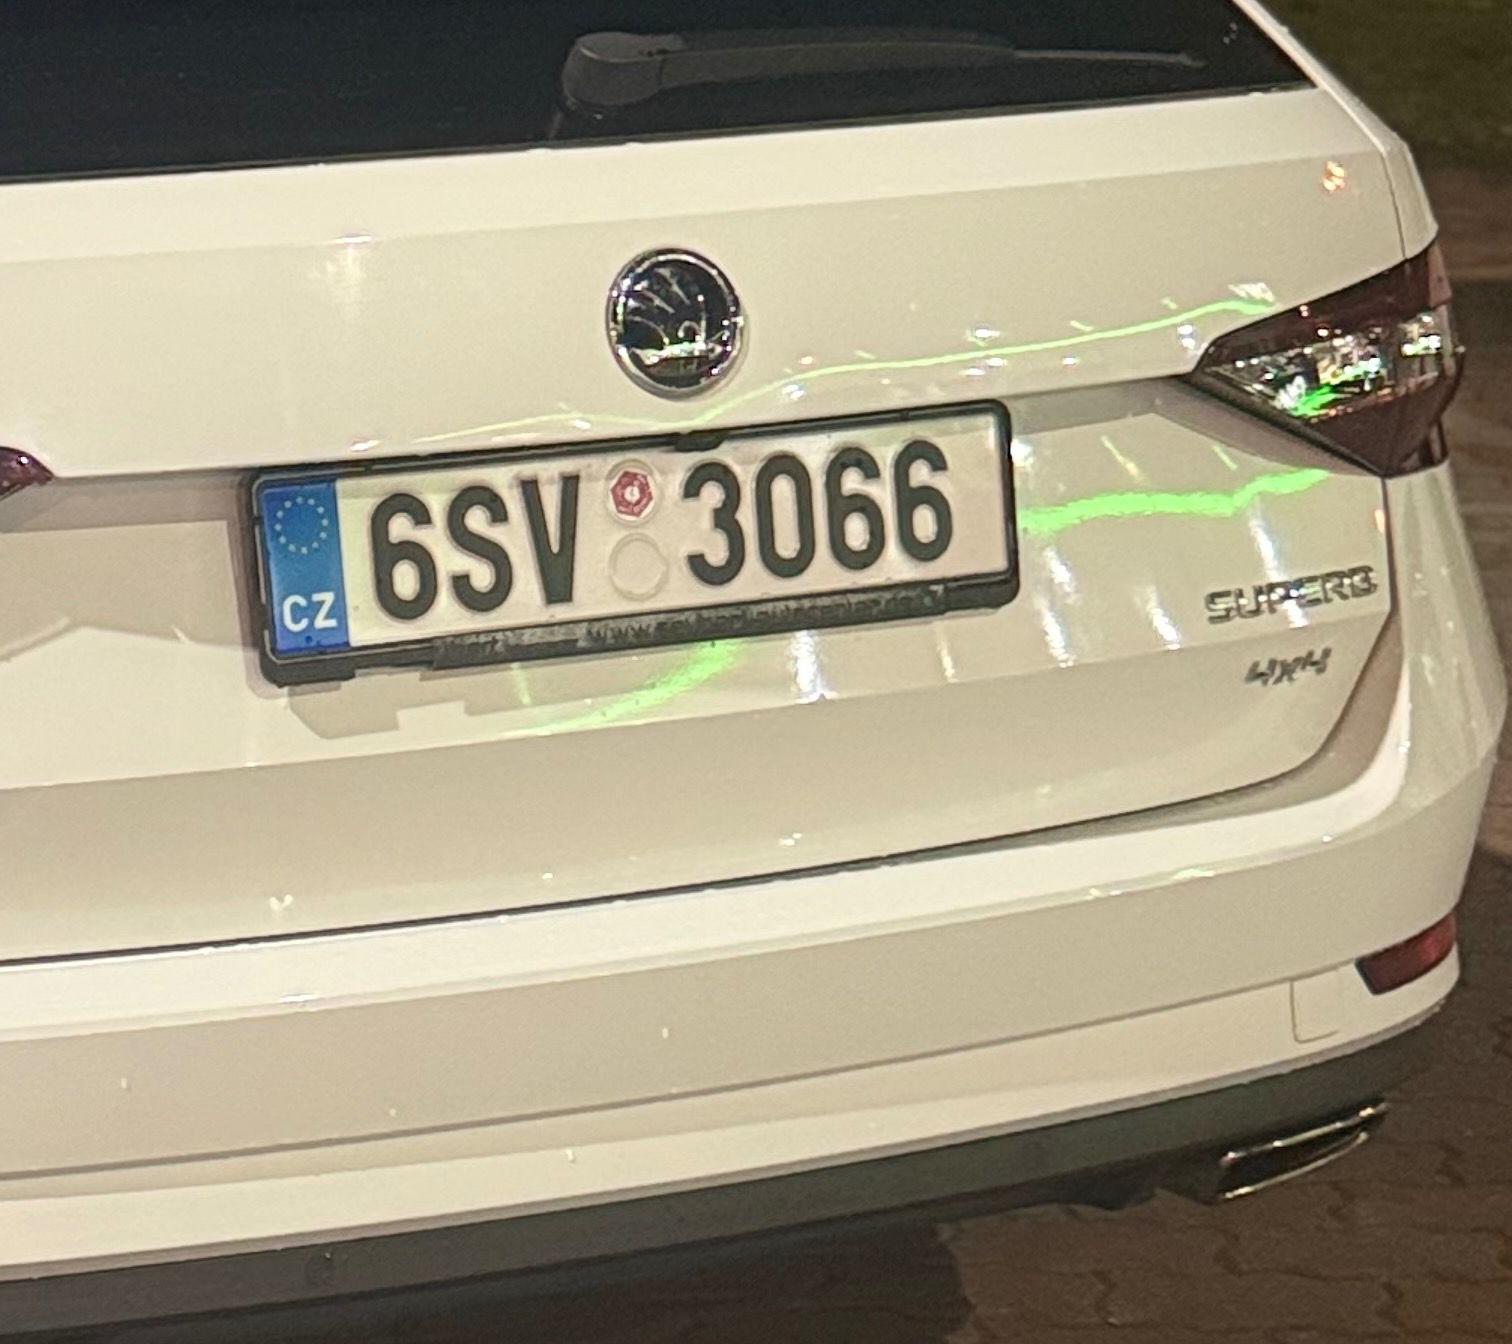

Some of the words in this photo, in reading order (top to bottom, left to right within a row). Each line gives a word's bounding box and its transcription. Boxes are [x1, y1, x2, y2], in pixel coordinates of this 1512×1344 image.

[370, 473, 580, 622] 6SV
[681, 440, 952, 587] 3066
[283, 592, 338, 632] CZ
[1205, 566, 1378, 624] SUPERB
